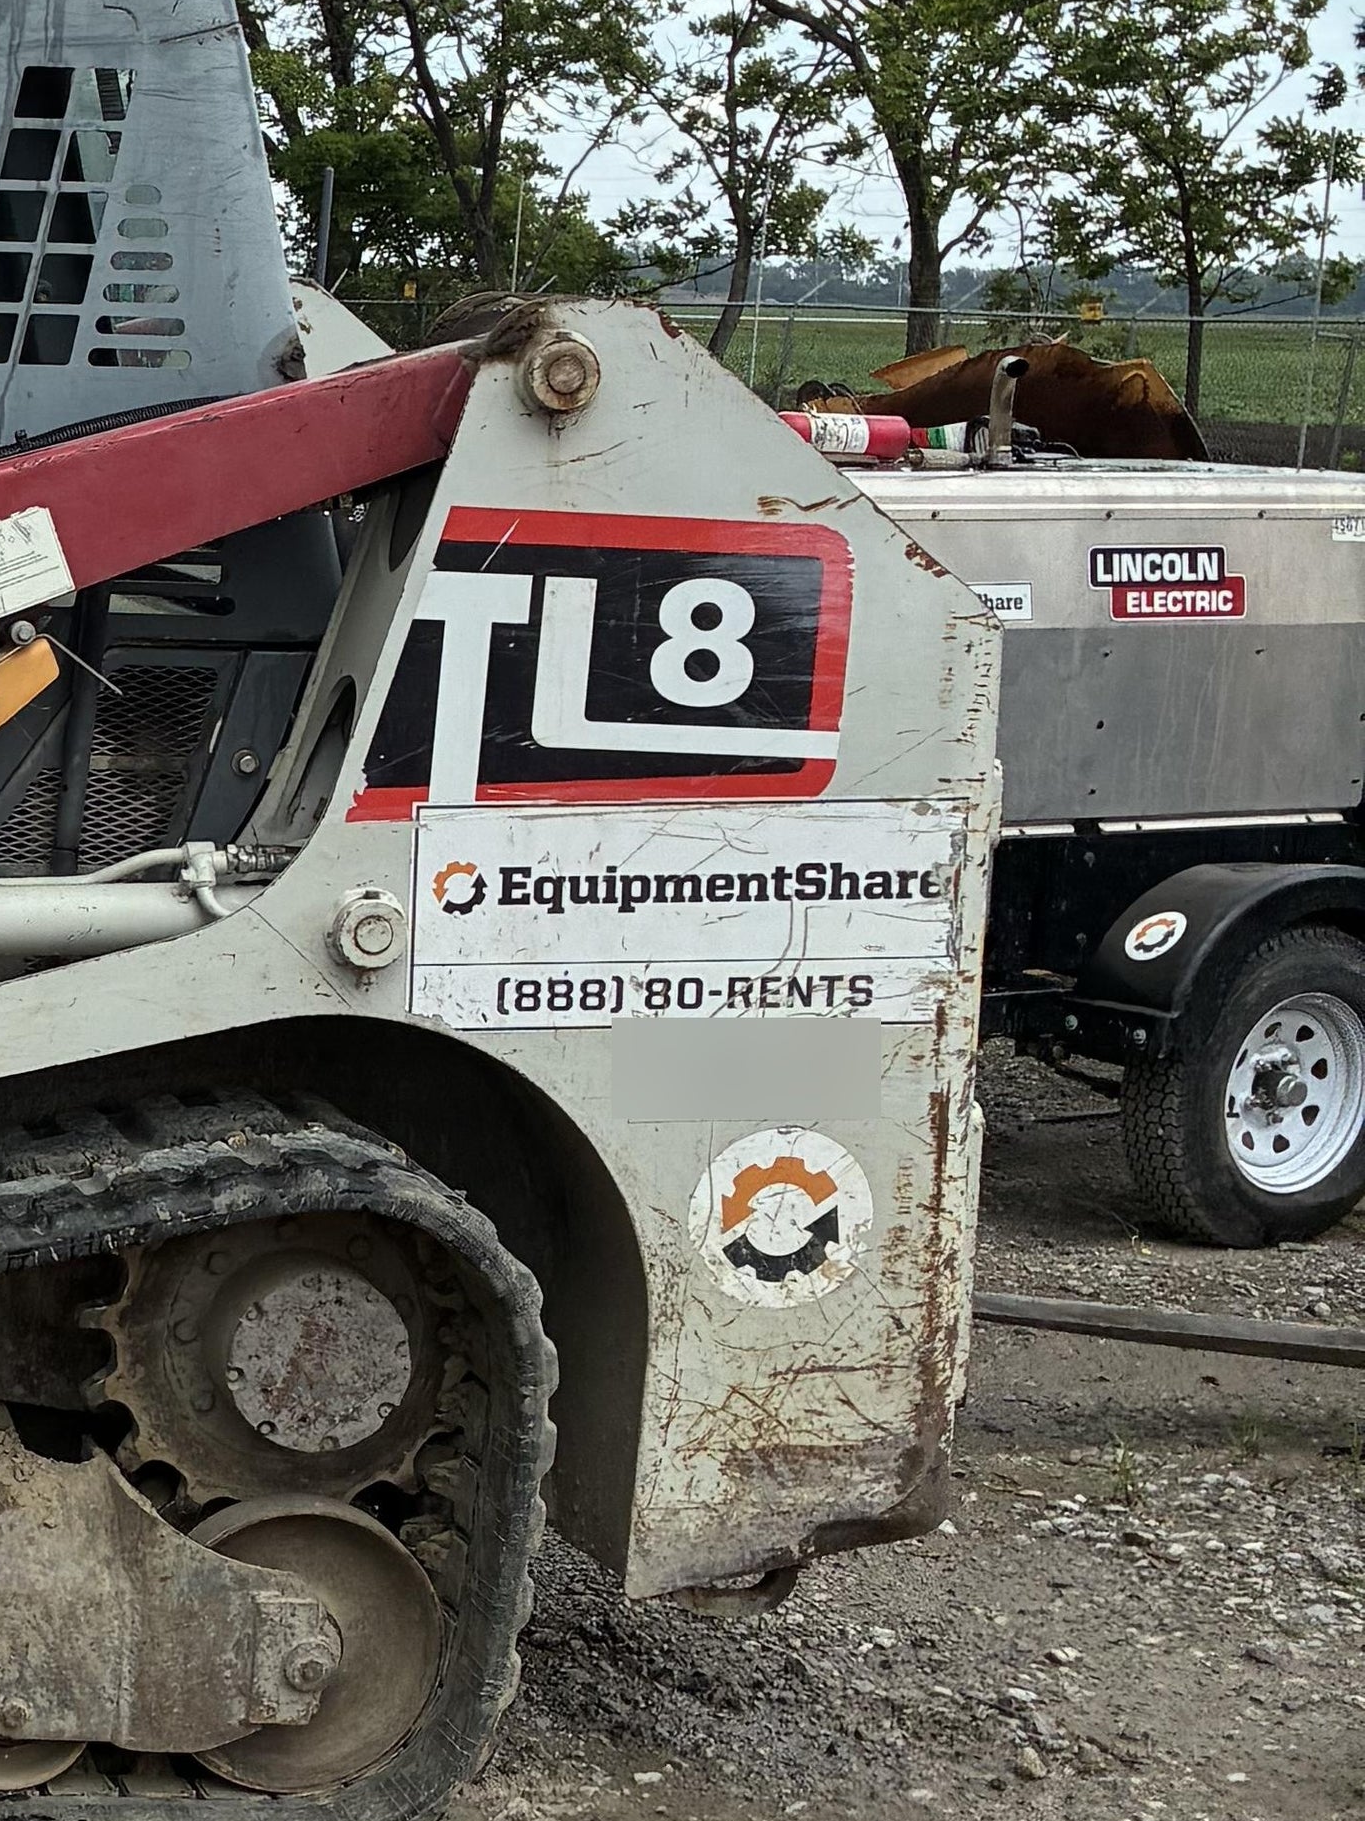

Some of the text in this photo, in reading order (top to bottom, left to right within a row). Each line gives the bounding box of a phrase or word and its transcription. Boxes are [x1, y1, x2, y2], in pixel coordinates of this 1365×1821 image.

[1096, 552, 1219, 583] LINCOLN
[1126, 590, 1234, 613] ELECTRIC
[412, 570, 841, 803] TL8
[497, 862, 944, 914] EquipmentShare
[496, 974, 875, 1014] (888) 80-RENTS
